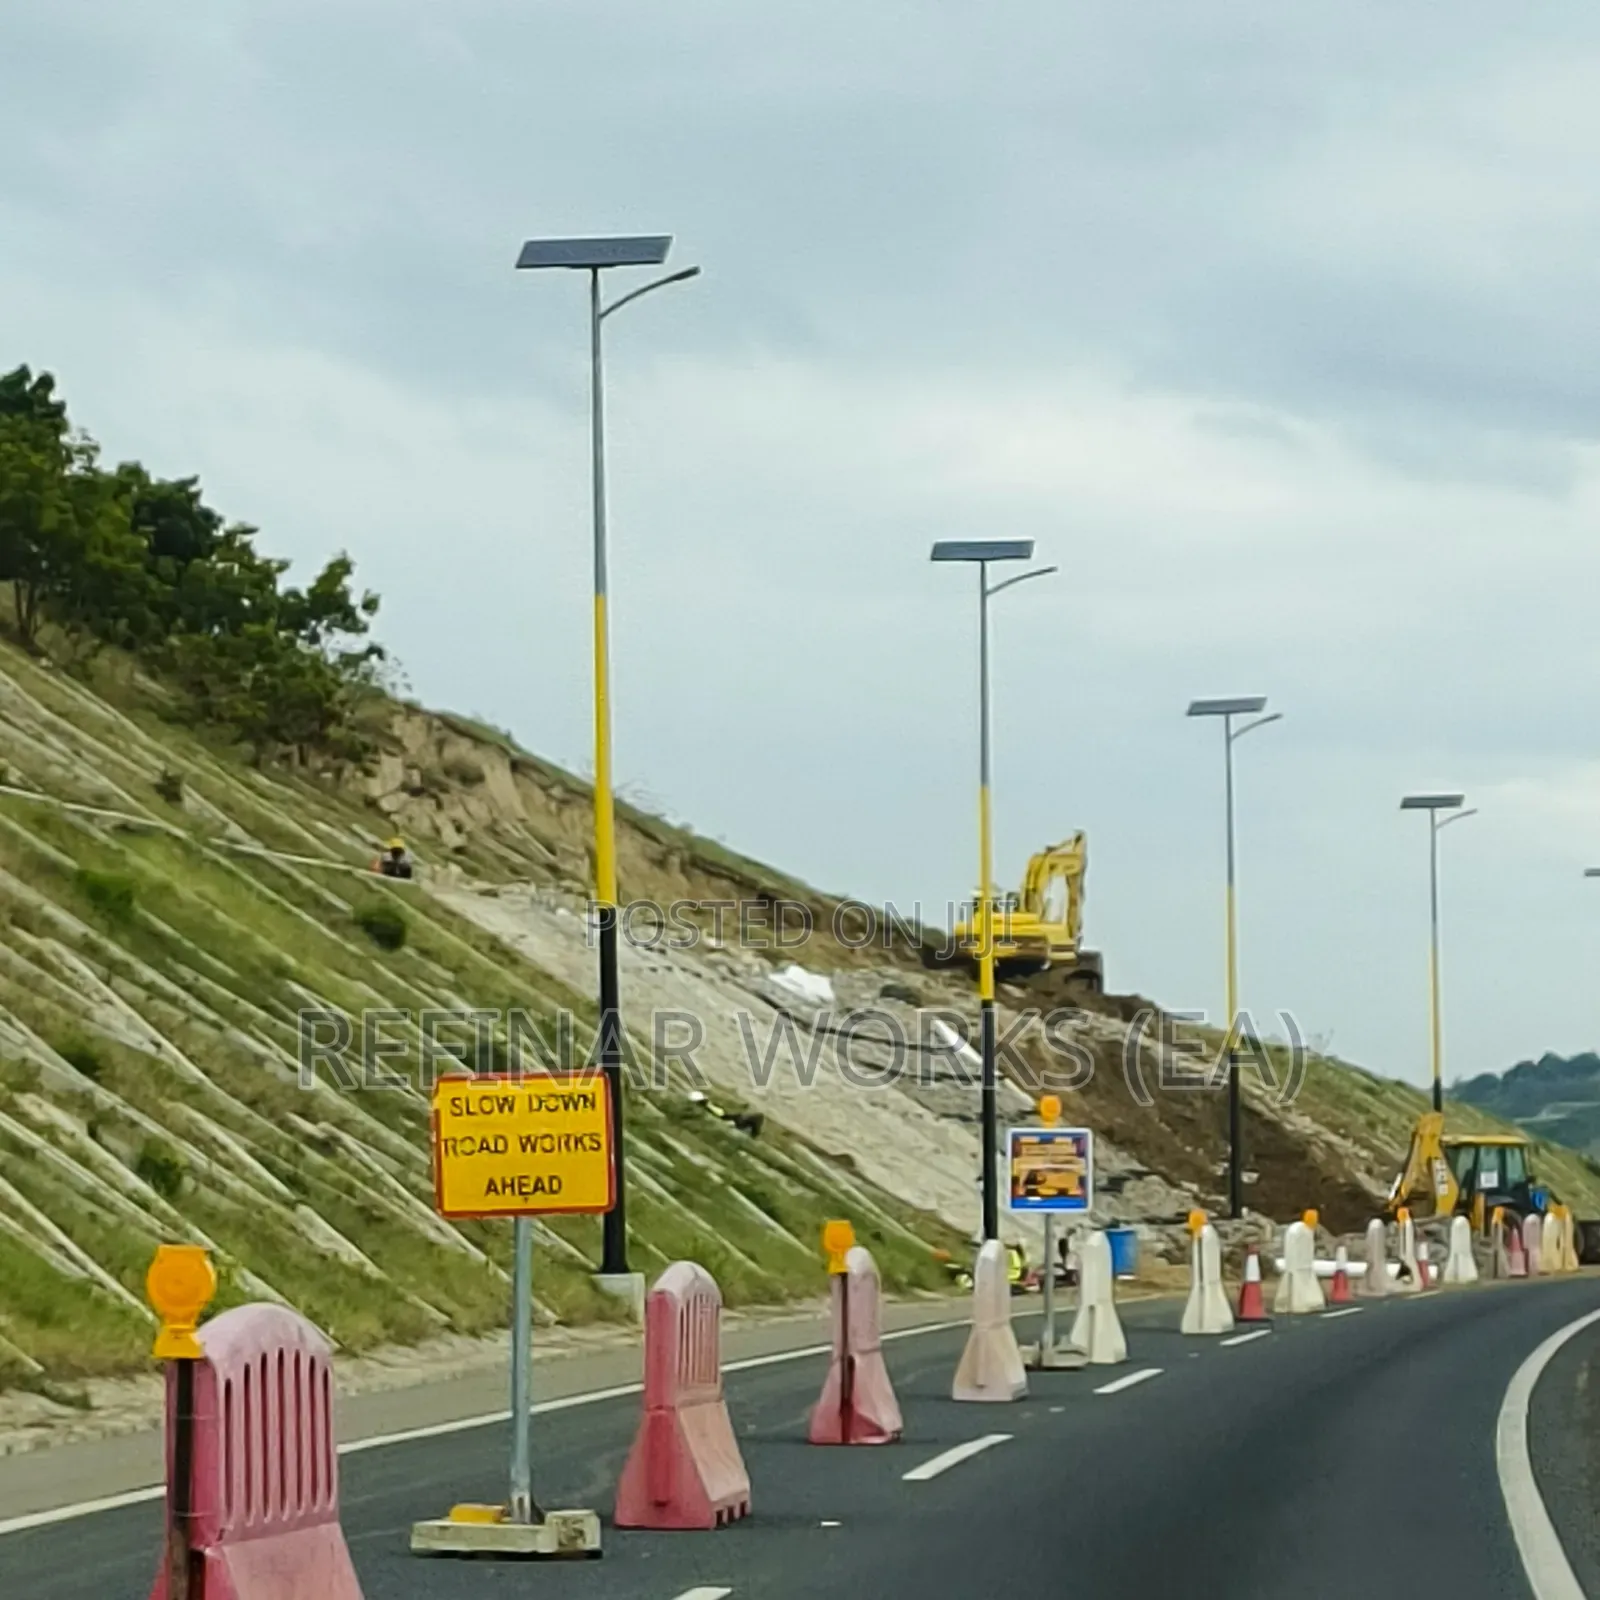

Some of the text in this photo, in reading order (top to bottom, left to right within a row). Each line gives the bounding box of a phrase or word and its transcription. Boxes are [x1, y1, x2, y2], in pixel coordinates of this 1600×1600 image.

[450, 1092, 596, 1117] SLOW DOWN
[442, 1132, 602, 1158] ROAD WORKS
[484, 1175, 563, 1197] AHEAD
